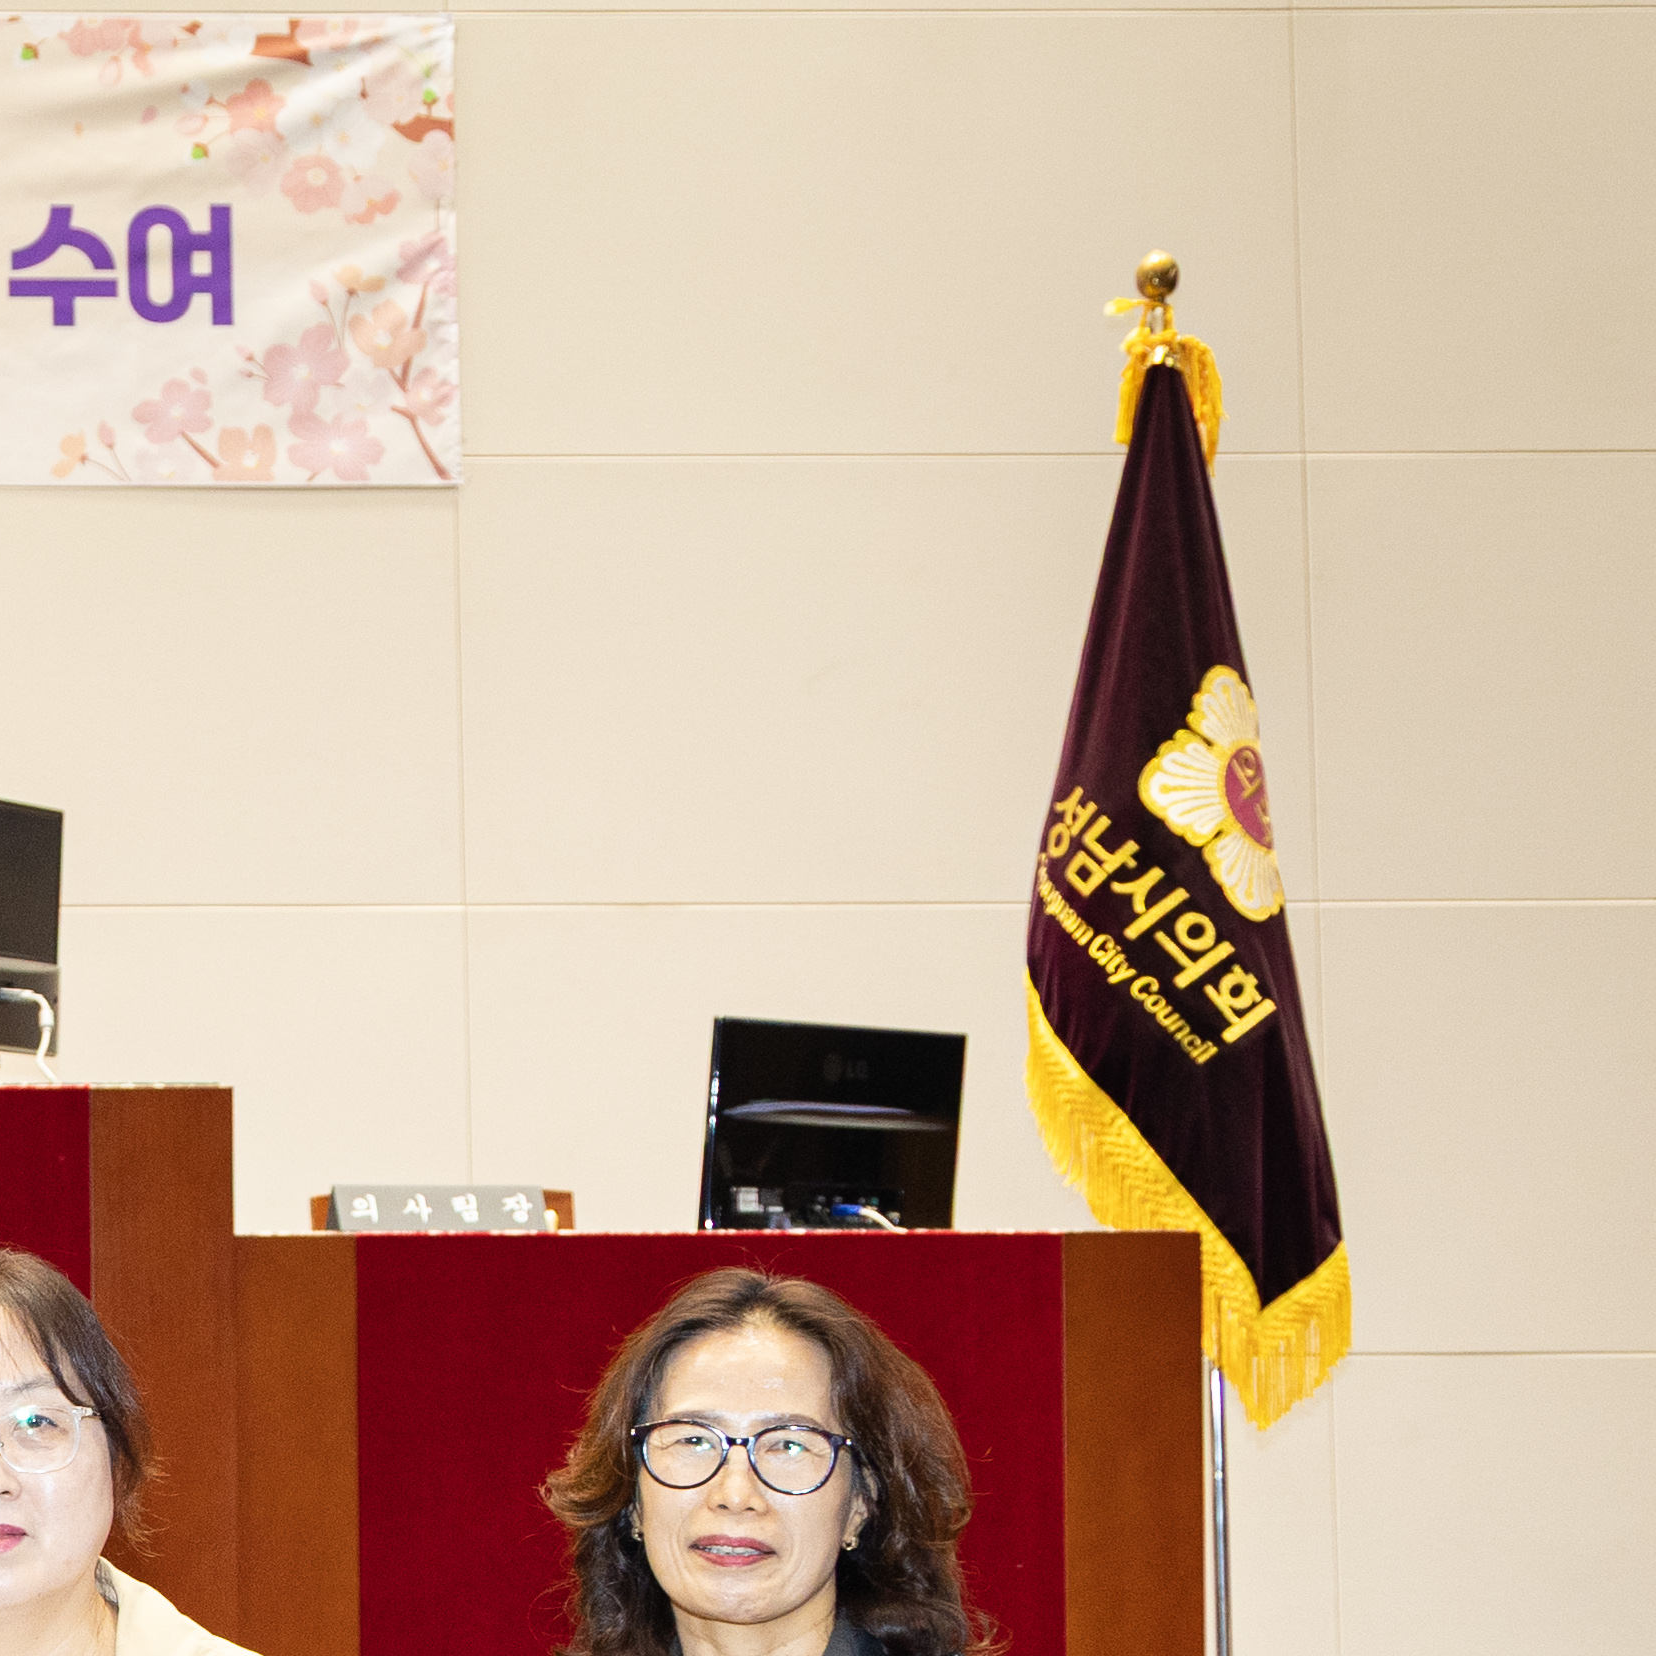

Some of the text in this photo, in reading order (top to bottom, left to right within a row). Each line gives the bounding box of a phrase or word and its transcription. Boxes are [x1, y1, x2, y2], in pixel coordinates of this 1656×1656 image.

[7, 200, 236, 328] 수여
[1047, 786, 1277, 1044] 성남시의회
[1089, 933, 1137, 984] City
[1130, 976, 1218, 1064] Council
